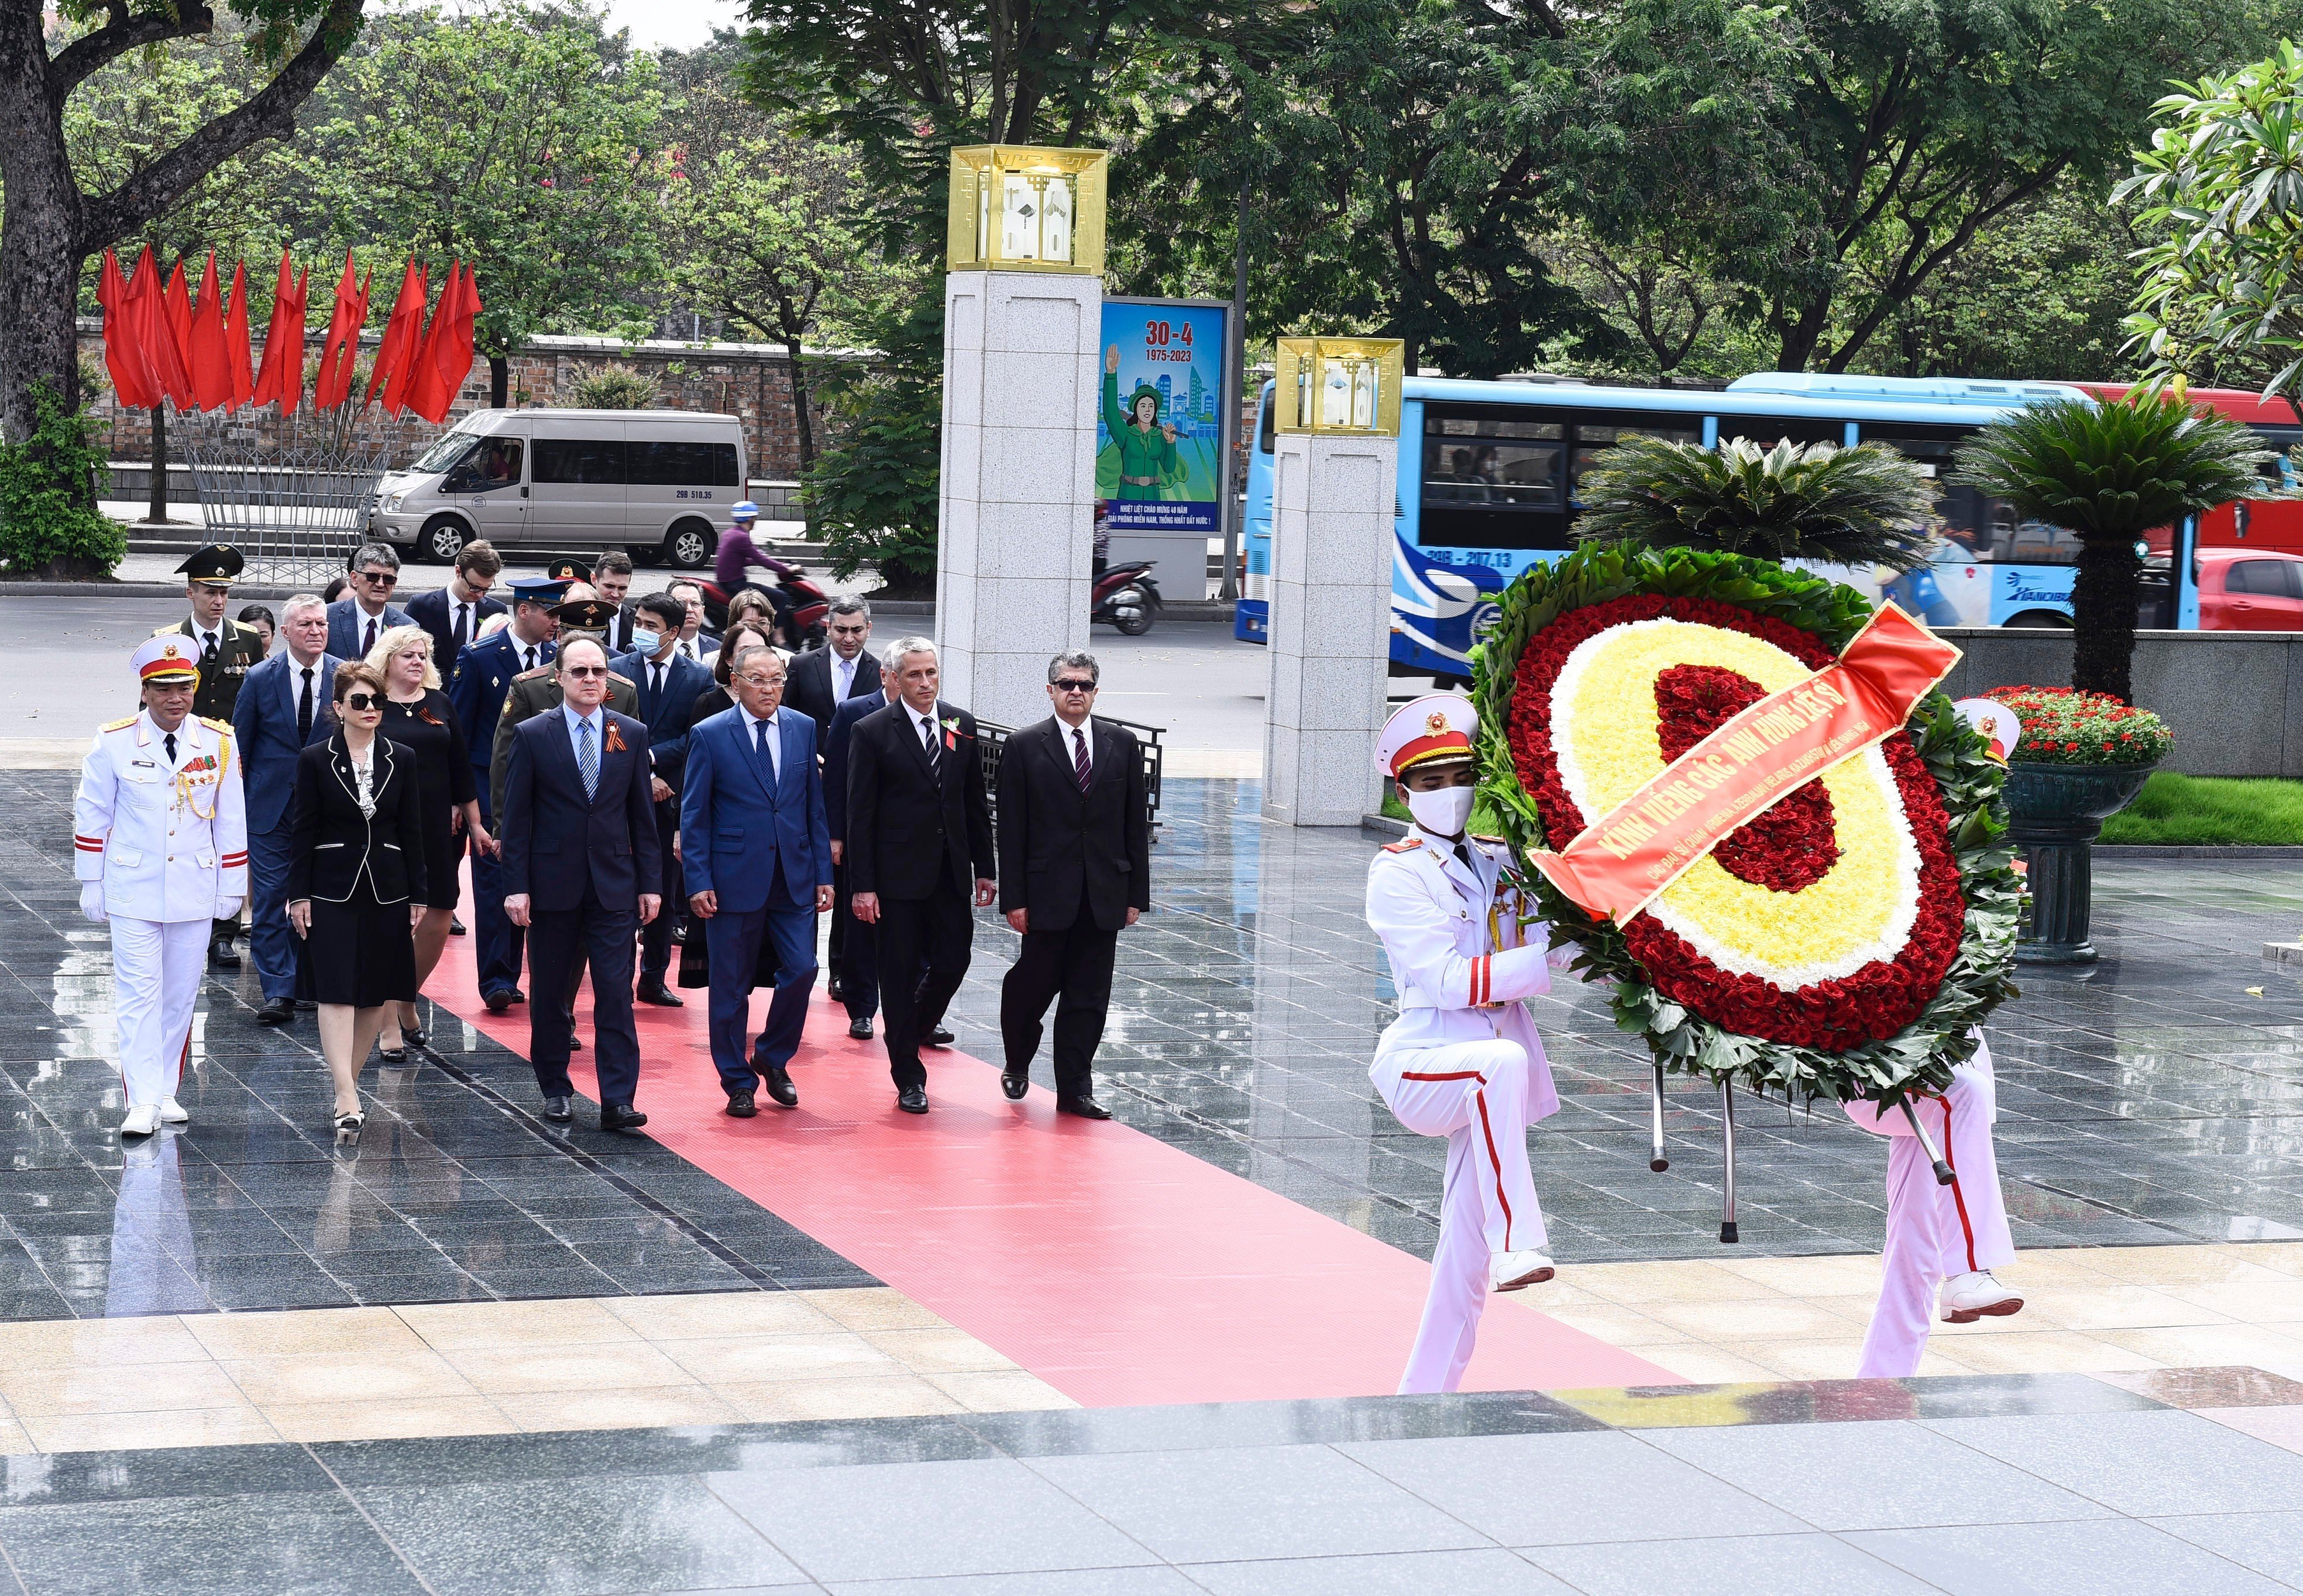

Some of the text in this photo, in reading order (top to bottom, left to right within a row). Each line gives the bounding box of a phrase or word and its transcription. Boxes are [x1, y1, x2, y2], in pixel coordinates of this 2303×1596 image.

[1146, 349, 1191, 362] 1975-2023
[676, 490, 712, 499] 29B 510.35
[1120, 504, 1133, 514] NHIỆT
[1134, 504, 1143, 514] LIỆT
[1143, 504, 1156, 514] CHÀO
[1157, 504, 1170, 514] MỪNG
[1177, 505, 1188, 514] NĂM
[1118, 514, 1133, 523] PHÓNG
[1146, 515, 1158, 525] NAM,
[1159, 514, 1173, 524] THỐNG
[1174, 514, 1185, 525] NHẤT
[1186, 515, 1195, 525] ĐẤT
[1195, 515, 1208, 525] NƯỚC
[1597, 678, 1848, 861] KÍNH VIẾNG CÁC ANH HÙNG LIỆT SĨ
[1647, 864, 1667, 880] CÁC
[1660, 851, 1680, 869] ĐẠI
[1673, 835, 1689, 856] SỨ
[1837, 729, 1859, 744] BANG
[1852, 720, 1871, 734] NGA
